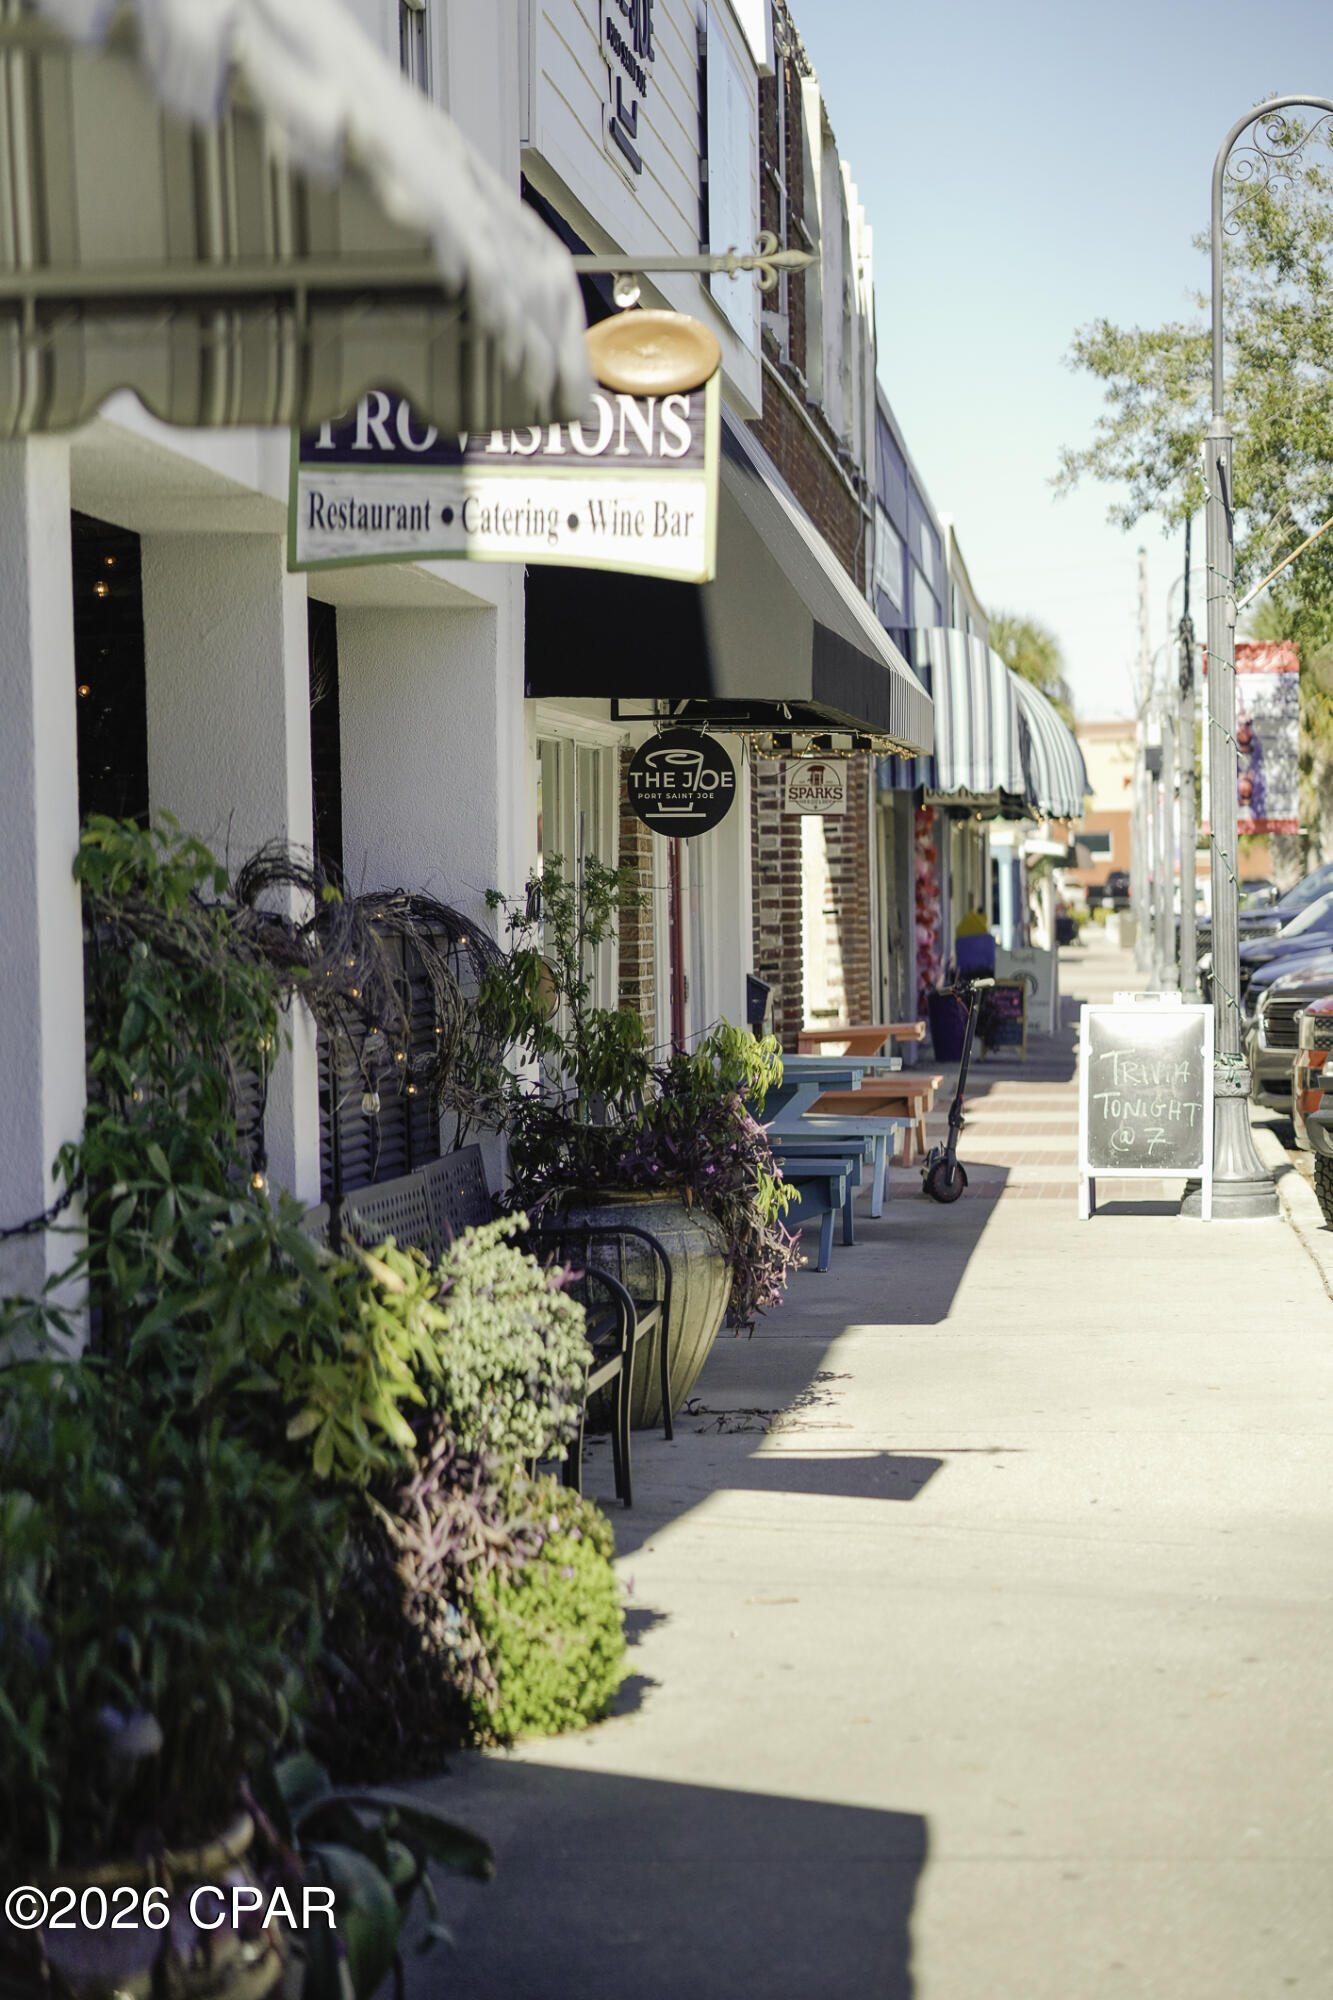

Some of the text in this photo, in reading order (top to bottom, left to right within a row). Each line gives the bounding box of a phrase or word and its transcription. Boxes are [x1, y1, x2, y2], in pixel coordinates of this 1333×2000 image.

[314, 389, 692, 458] ROIONS
[309, 490, 694, 545] Restaurant Catering Wine Bar
[630, 769, 733, 791] THE JOE
[788, 787, 843, 800] SPARKS
[1093, 1092, 1202, 1127] TONIGHT
[1111, 1126, 1167, 1155] @ 7
